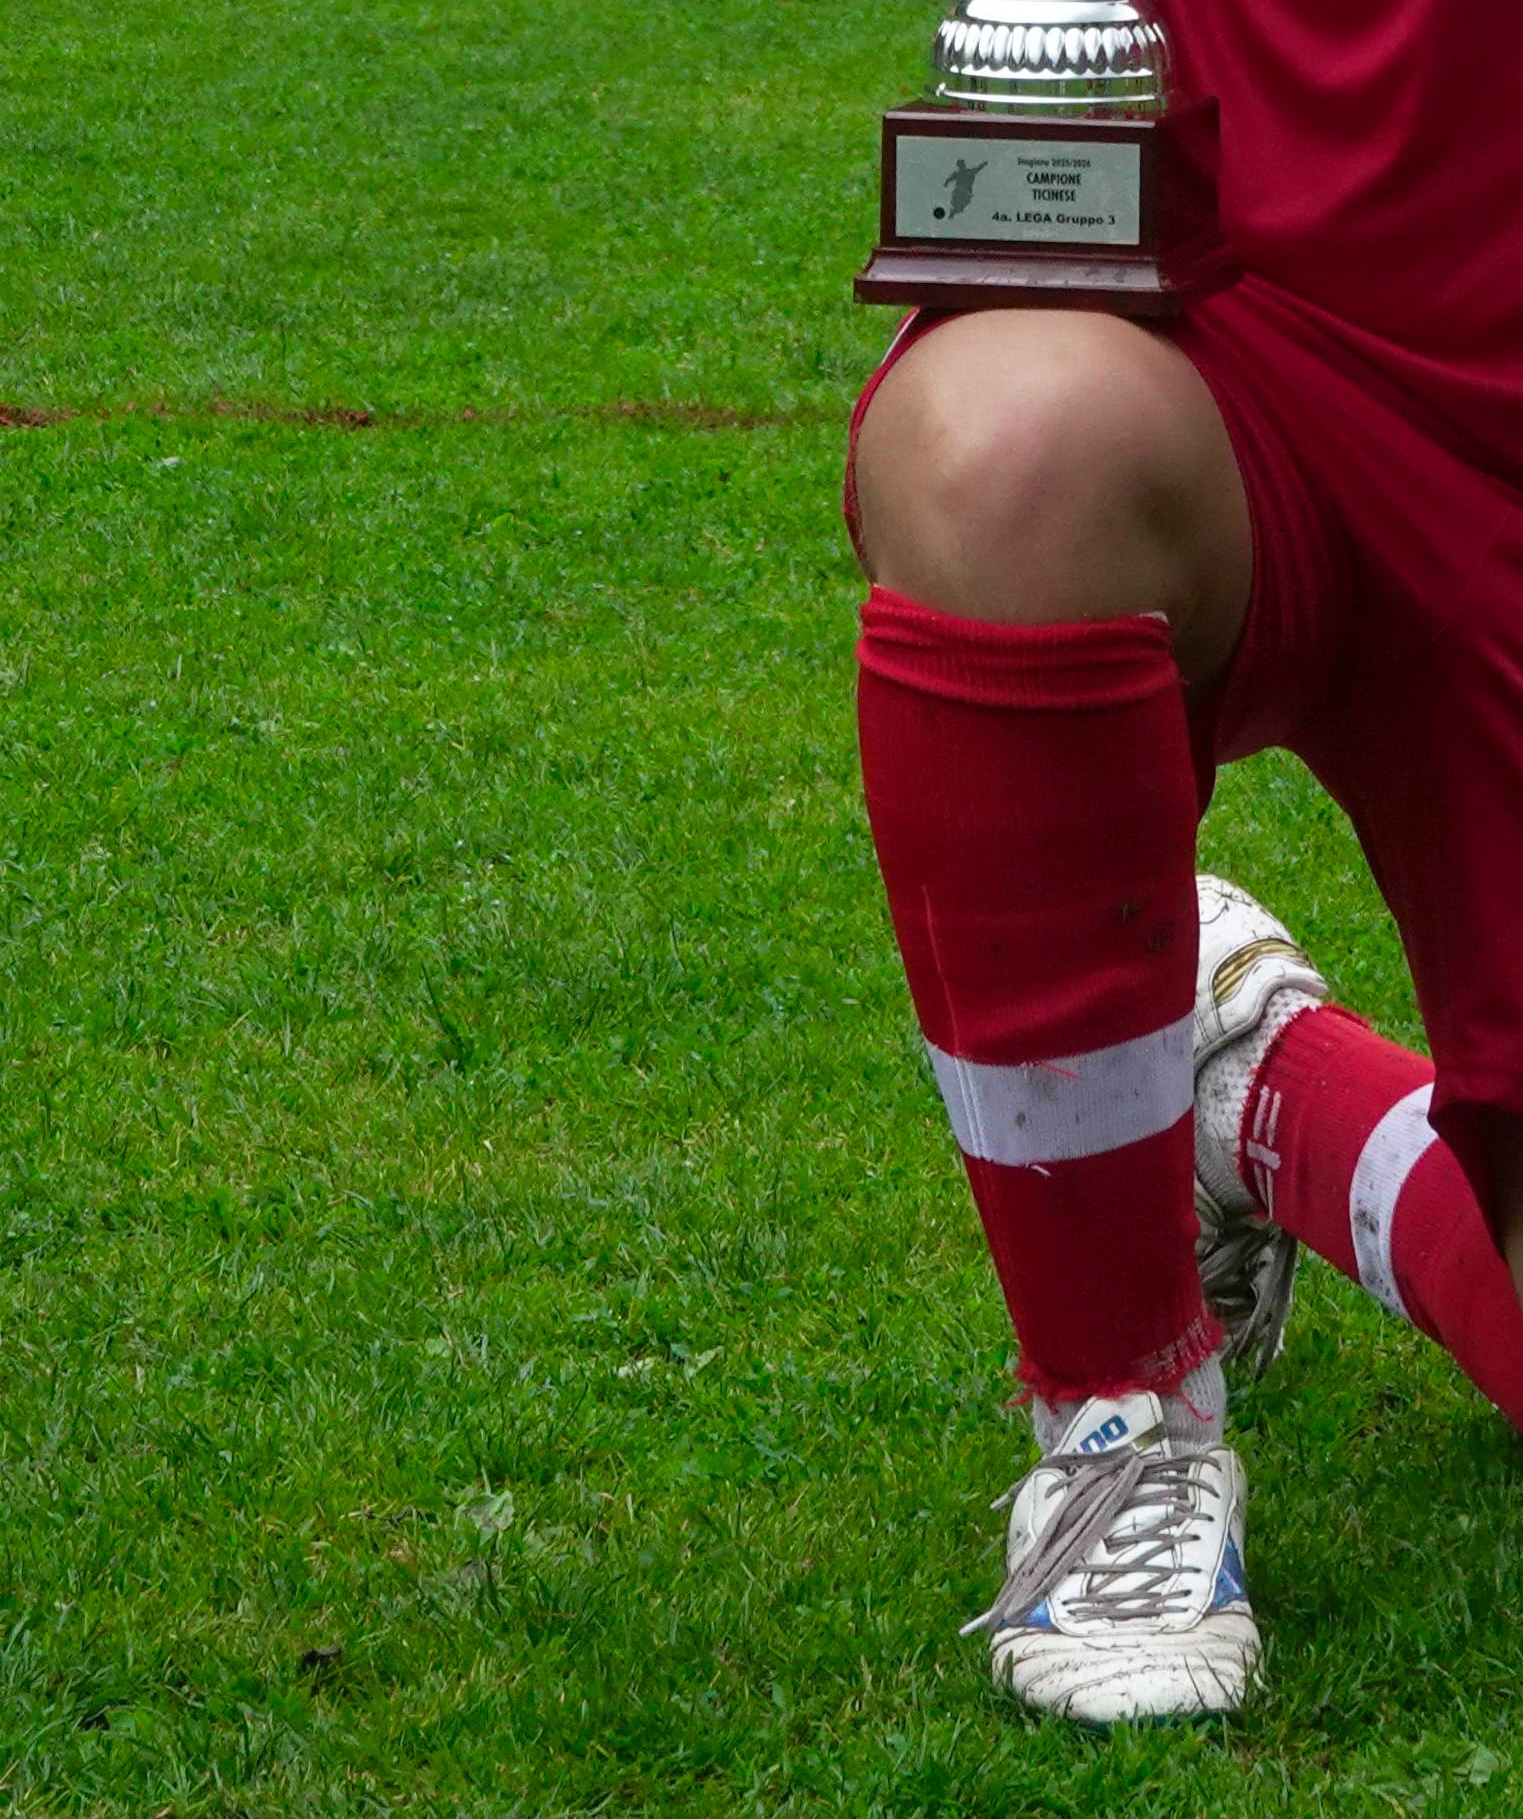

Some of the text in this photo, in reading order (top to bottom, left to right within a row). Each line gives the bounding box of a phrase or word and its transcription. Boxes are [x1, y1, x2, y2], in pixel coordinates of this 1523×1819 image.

[1026, 172, 1082, 186] CAMPIONE
[1032, 189, 1076, 202] TICINESE
[1016, 211, 1052, 224] LEGA
[1056, 213, 1104, 228] Gruppo
[1108, 215, 1116, 225] 3
